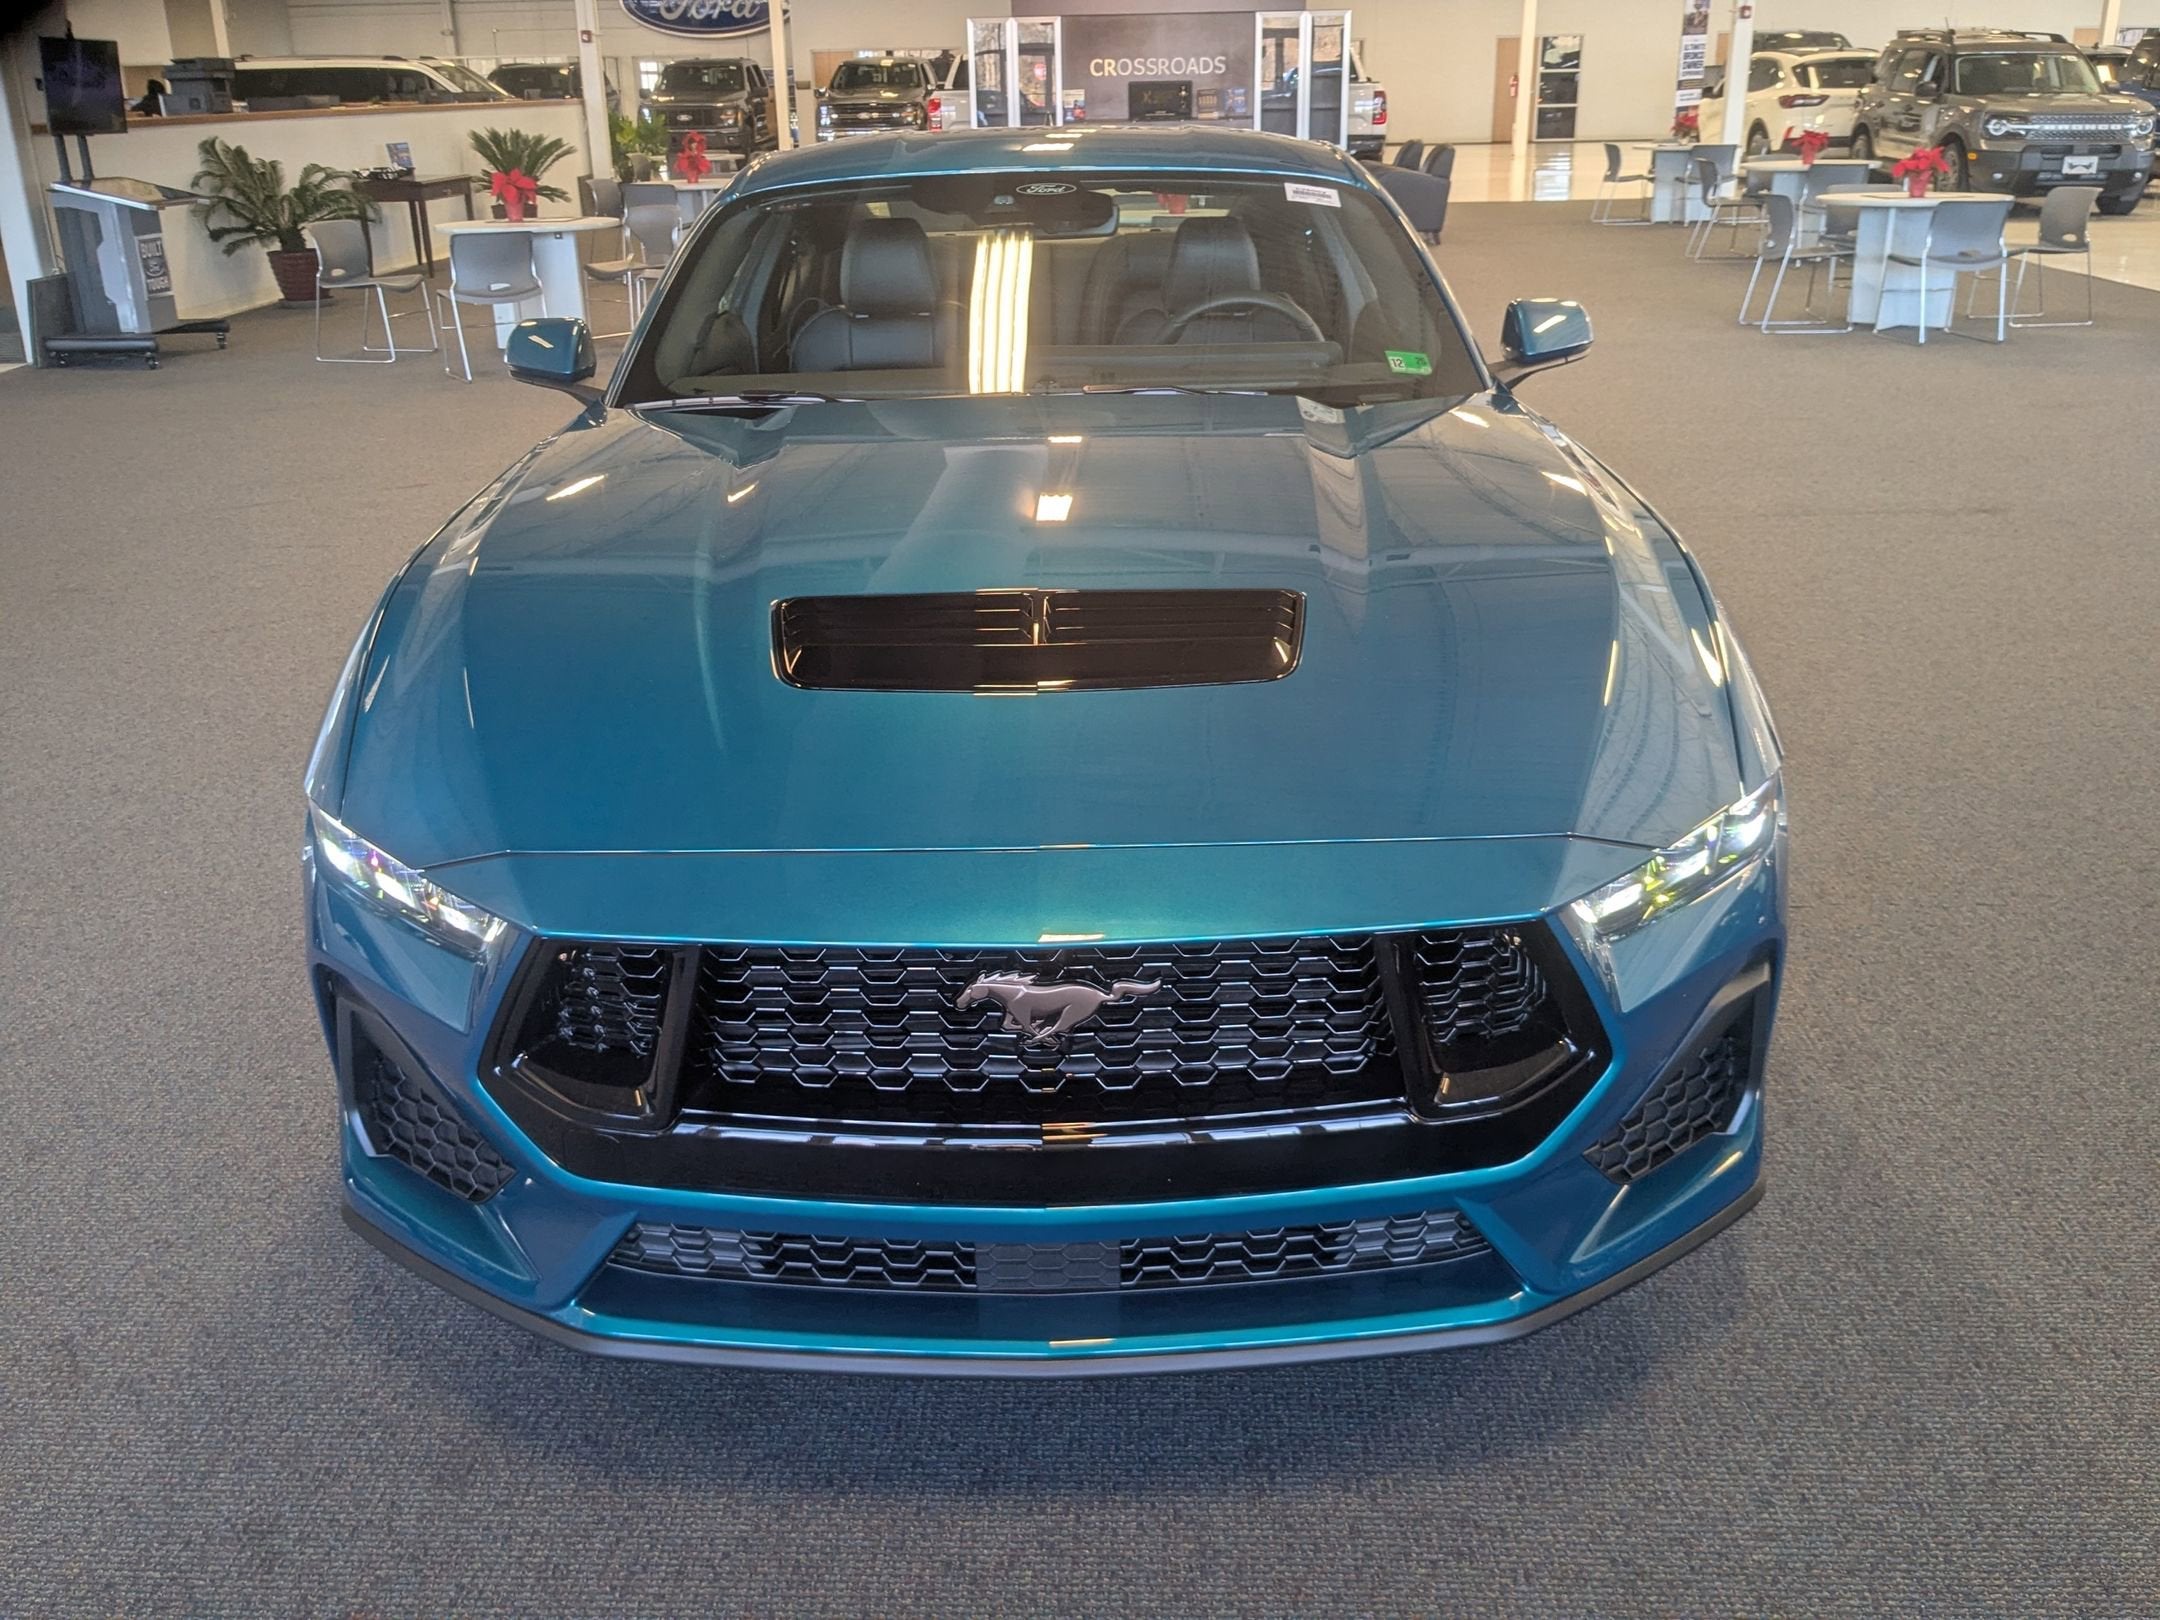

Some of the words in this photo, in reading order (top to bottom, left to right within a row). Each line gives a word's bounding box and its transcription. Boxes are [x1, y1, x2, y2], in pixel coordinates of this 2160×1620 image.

[1089, 56, 1227, 77] CROSSROADS
[1027, 184, 1066, 194] Ford
[140, 240, 162, 259] BUILT
[147, 276, 169, 291] TOUGH
[1391, 358, 1404, 368] 12
